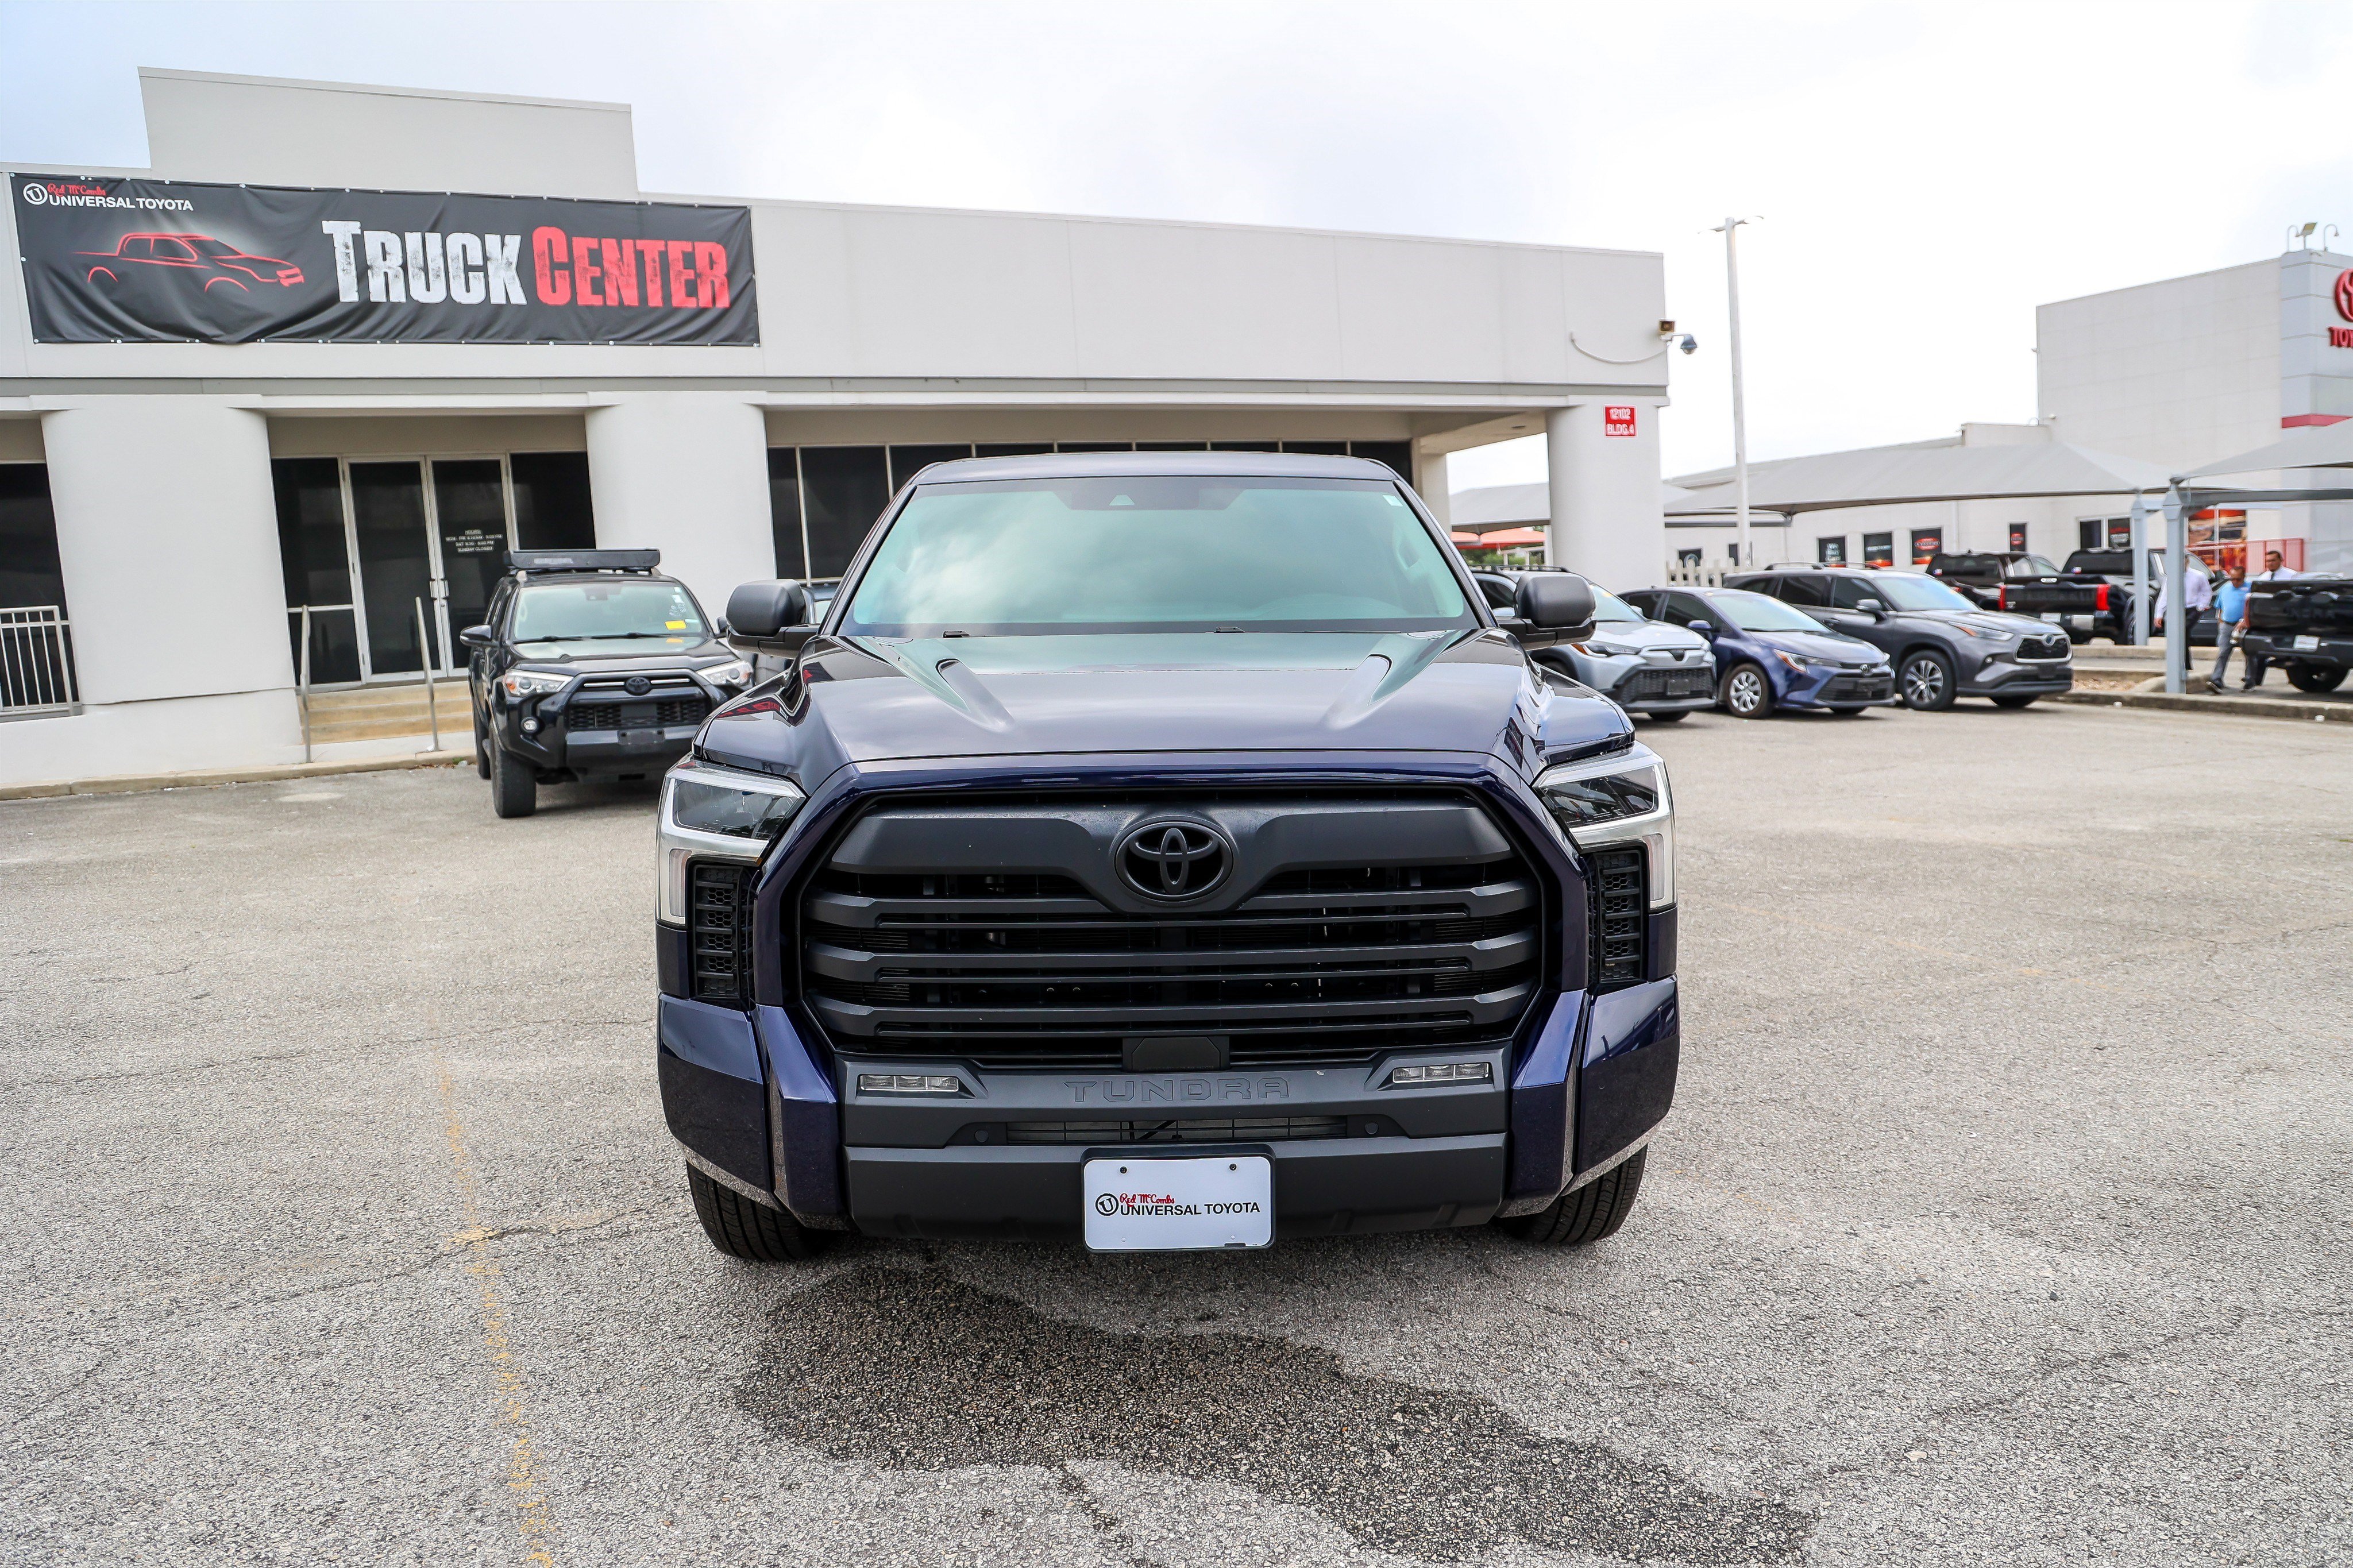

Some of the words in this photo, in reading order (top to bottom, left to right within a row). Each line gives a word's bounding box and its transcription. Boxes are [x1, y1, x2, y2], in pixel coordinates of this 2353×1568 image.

[48, 183, 65, 196] Red
[67, 184, 106, 196] McCombs
[49, 194, 136, 208] UNIVERSAL
[136, 197, 194, 211] TOYOTA
[321, 220, 527, 306] TRUCK
[531, 226, 730, 309] CENTER
[1063, 1077, 1290, 1102] TUNDRA
[1120, 1193, 1136, 1207] Red
[1137, 1193, 1175, 1204] McCombs
[1120, 1204, 1202, 1216] UNIVERSAL
[1203, 1202, 1260, 1215] TOYOTA
